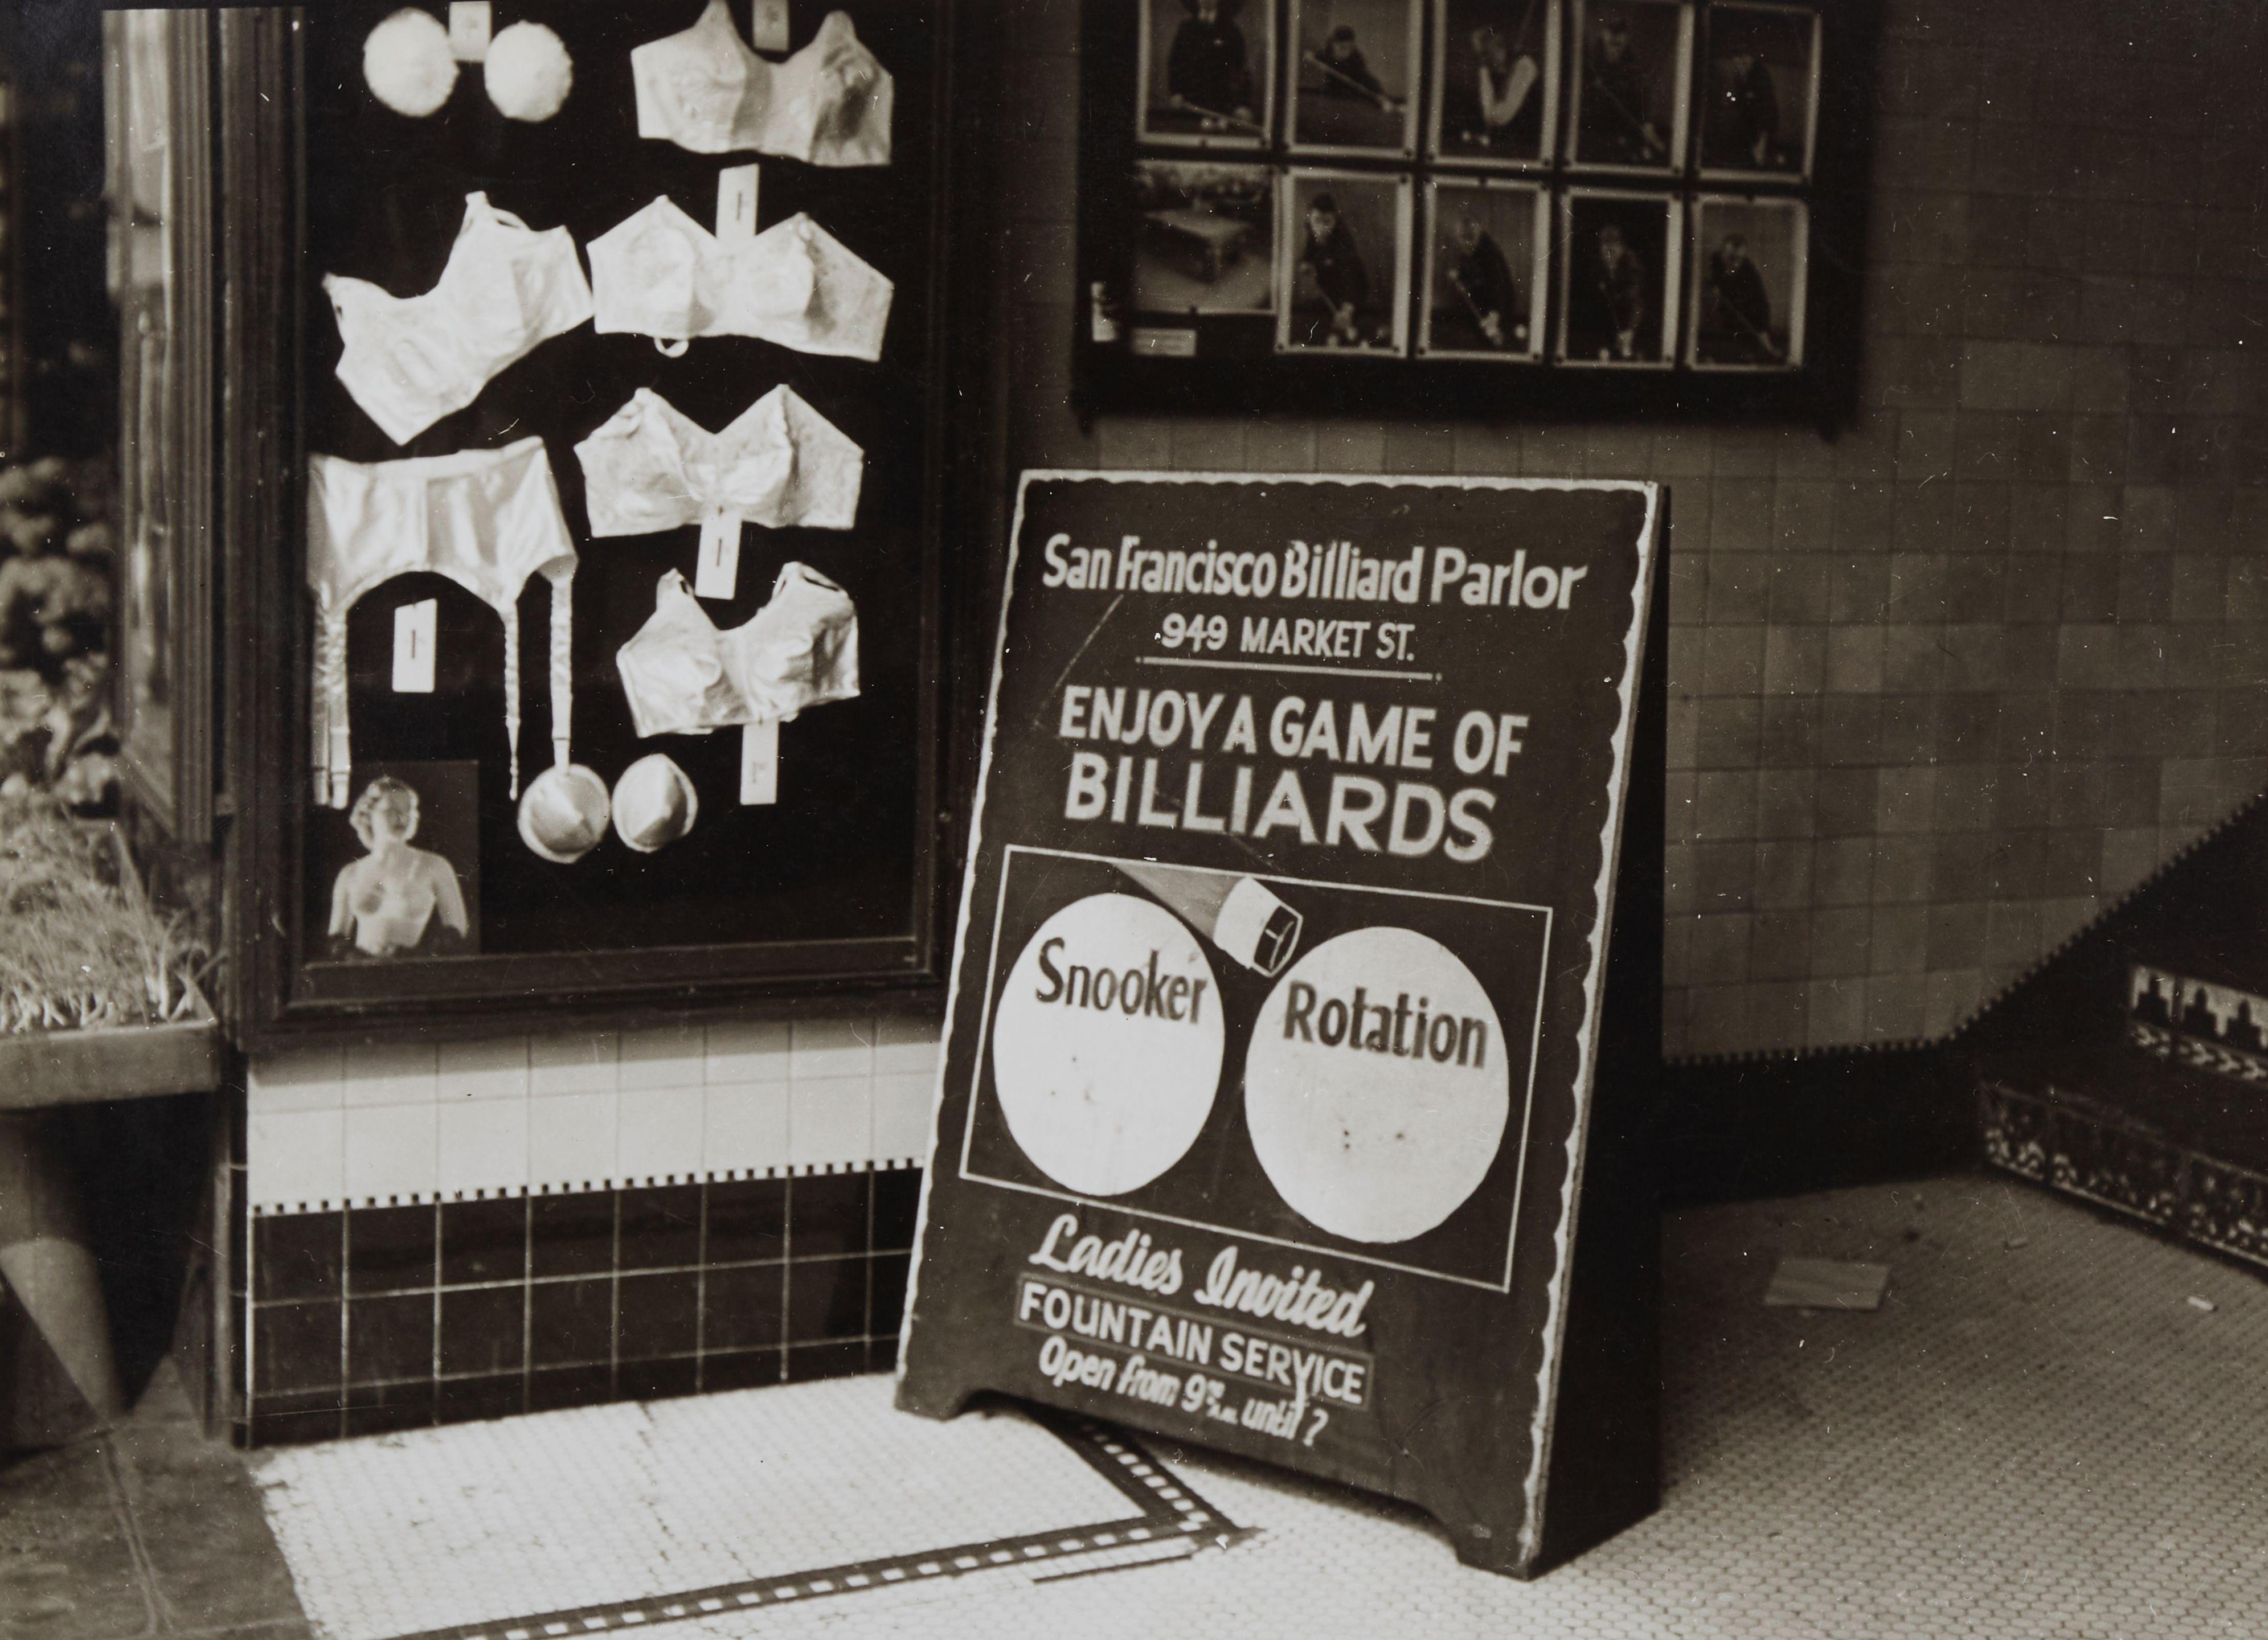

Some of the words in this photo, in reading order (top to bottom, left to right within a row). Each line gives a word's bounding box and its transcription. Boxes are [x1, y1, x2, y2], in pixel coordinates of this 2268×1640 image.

[1043, 532, 1110, 592] San
[1115, 536, 1278, 598] Francisco
[1280, 540, 1425, 603] Billiard
[1431, 546, 1588, 610] Parlor
[1161, 613, 1228, 652] 949
[1240, 616, 1370, 659] MARKET
[1375, 623, 1416, 662] ST.
[1059, 684, 1226, 753] ENJOY
[1223, 695, 1257, 755] A
[1270, 696, 1437, 771] GAME
[1453, 711, 1530, 777] OF
[1064, 753, 1497, 863] BILLIARDS
[1034, 936, 1208, 1026] Snooker
[1282, 980, 1487, 1070] Rotation
[1028, 1213, 1184, 1295] Ladies
[1194, 1245, 1375, 1338] Invited
[1019, 1282, 1213, 1365] FOUNTAIN
[1219, 1332, 1366, 1405] SERVICE
[1038, 1335, 1116, 1391] Open
[1116, 1354, 1181, 1407] from
[1241, 1391, 1310, 1440] until
